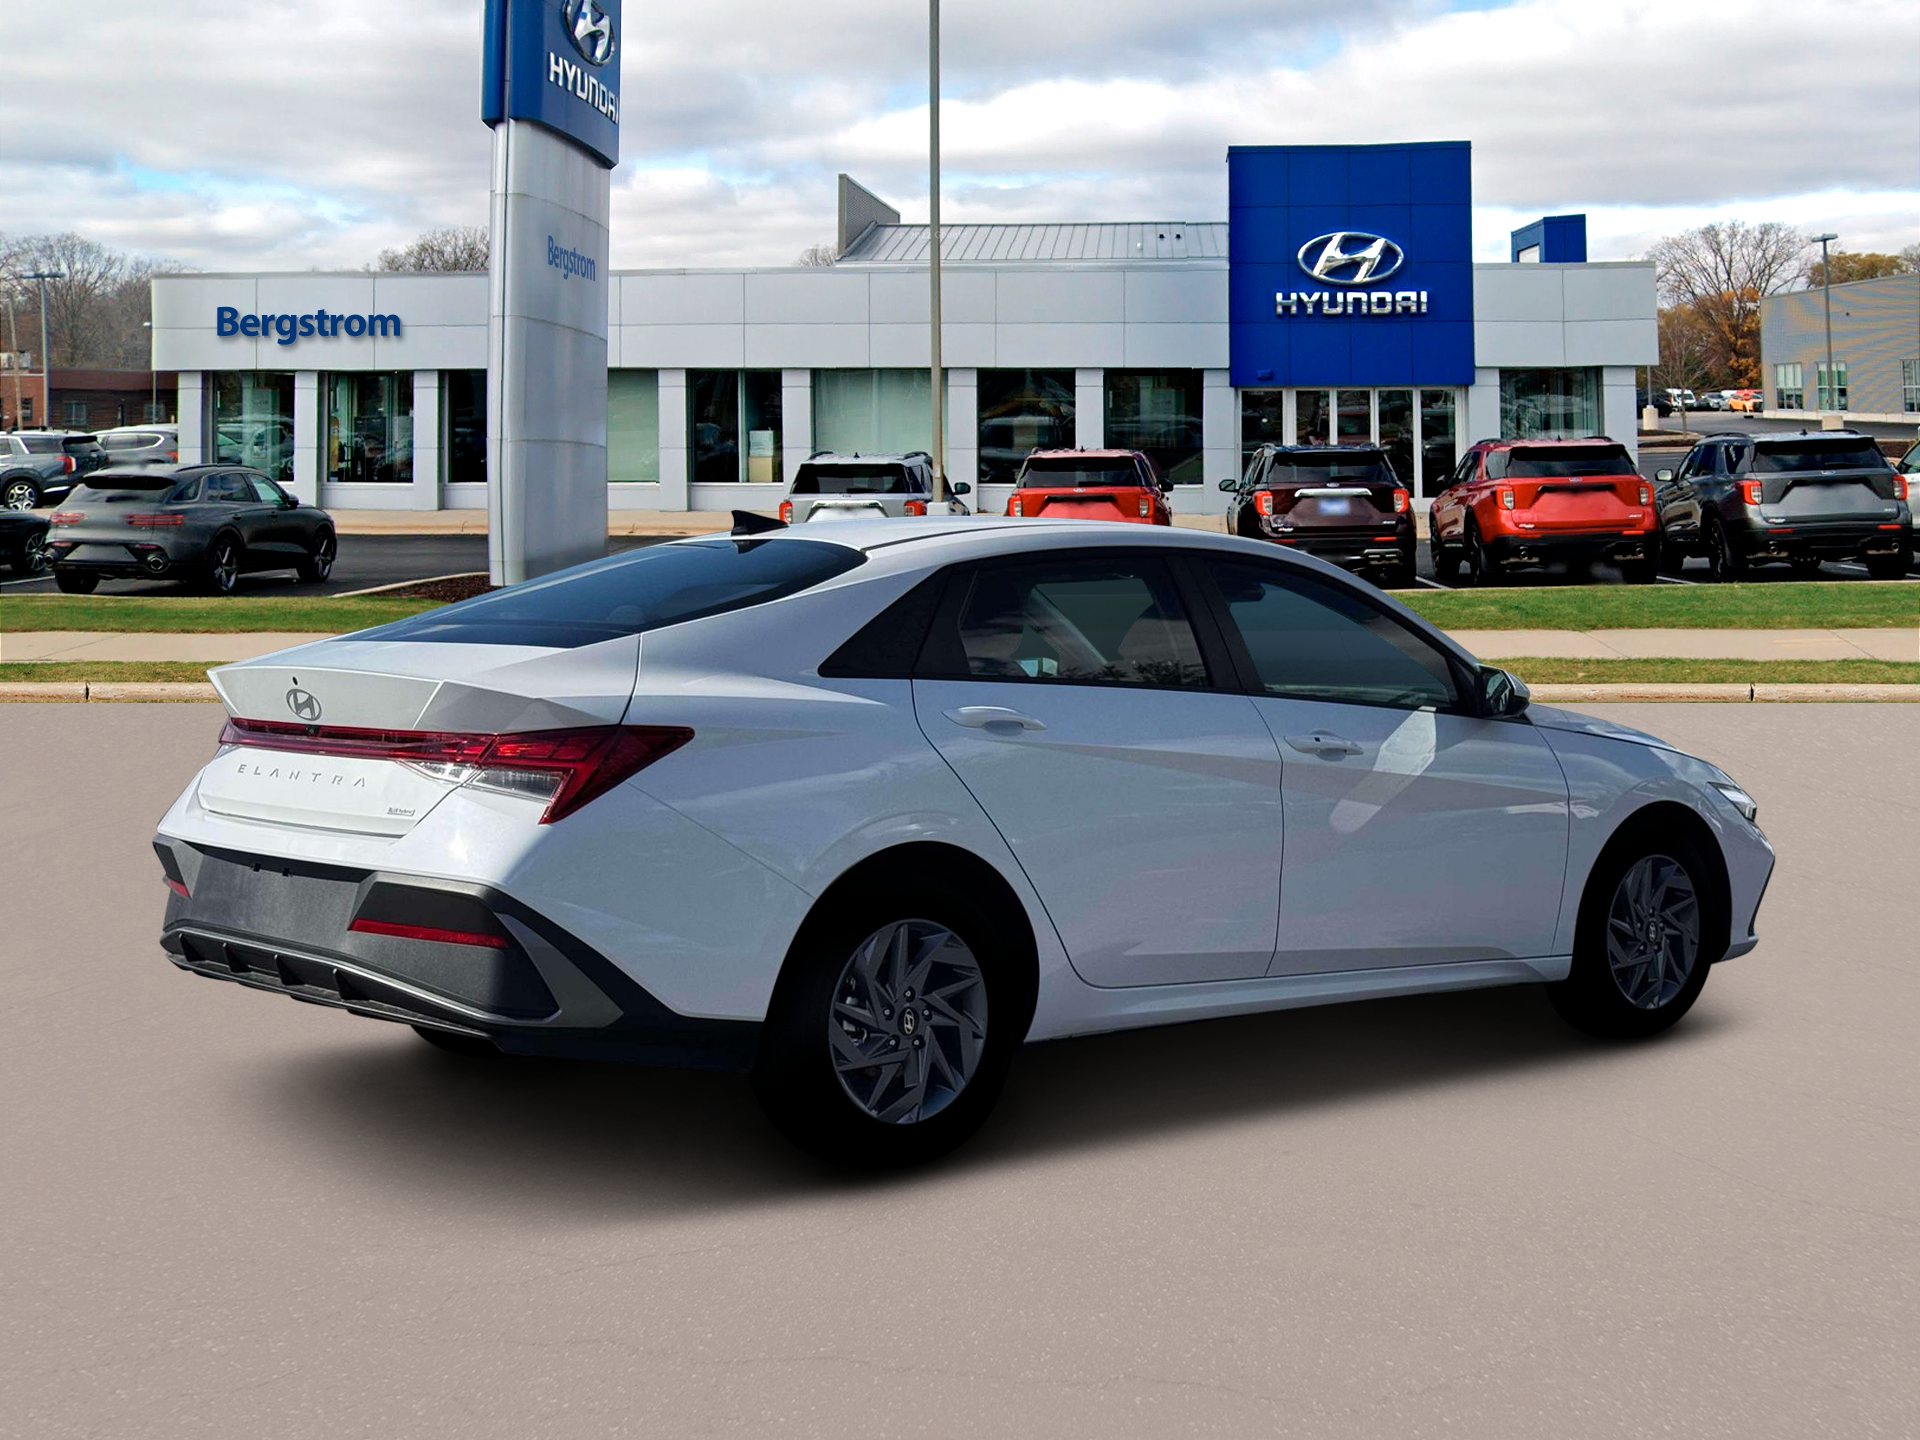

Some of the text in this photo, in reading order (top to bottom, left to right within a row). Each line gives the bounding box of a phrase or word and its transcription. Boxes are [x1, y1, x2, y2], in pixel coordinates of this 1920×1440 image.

[549, 52, 618, 124] HYUNDAI
[548, 235, 596, 282] Bergstrom
[1275, 290, 1428, 315] HYUNDAI
[216, 306, 401, 346] Bergstrom
[238, 764, 366, 788] ELANTRA
